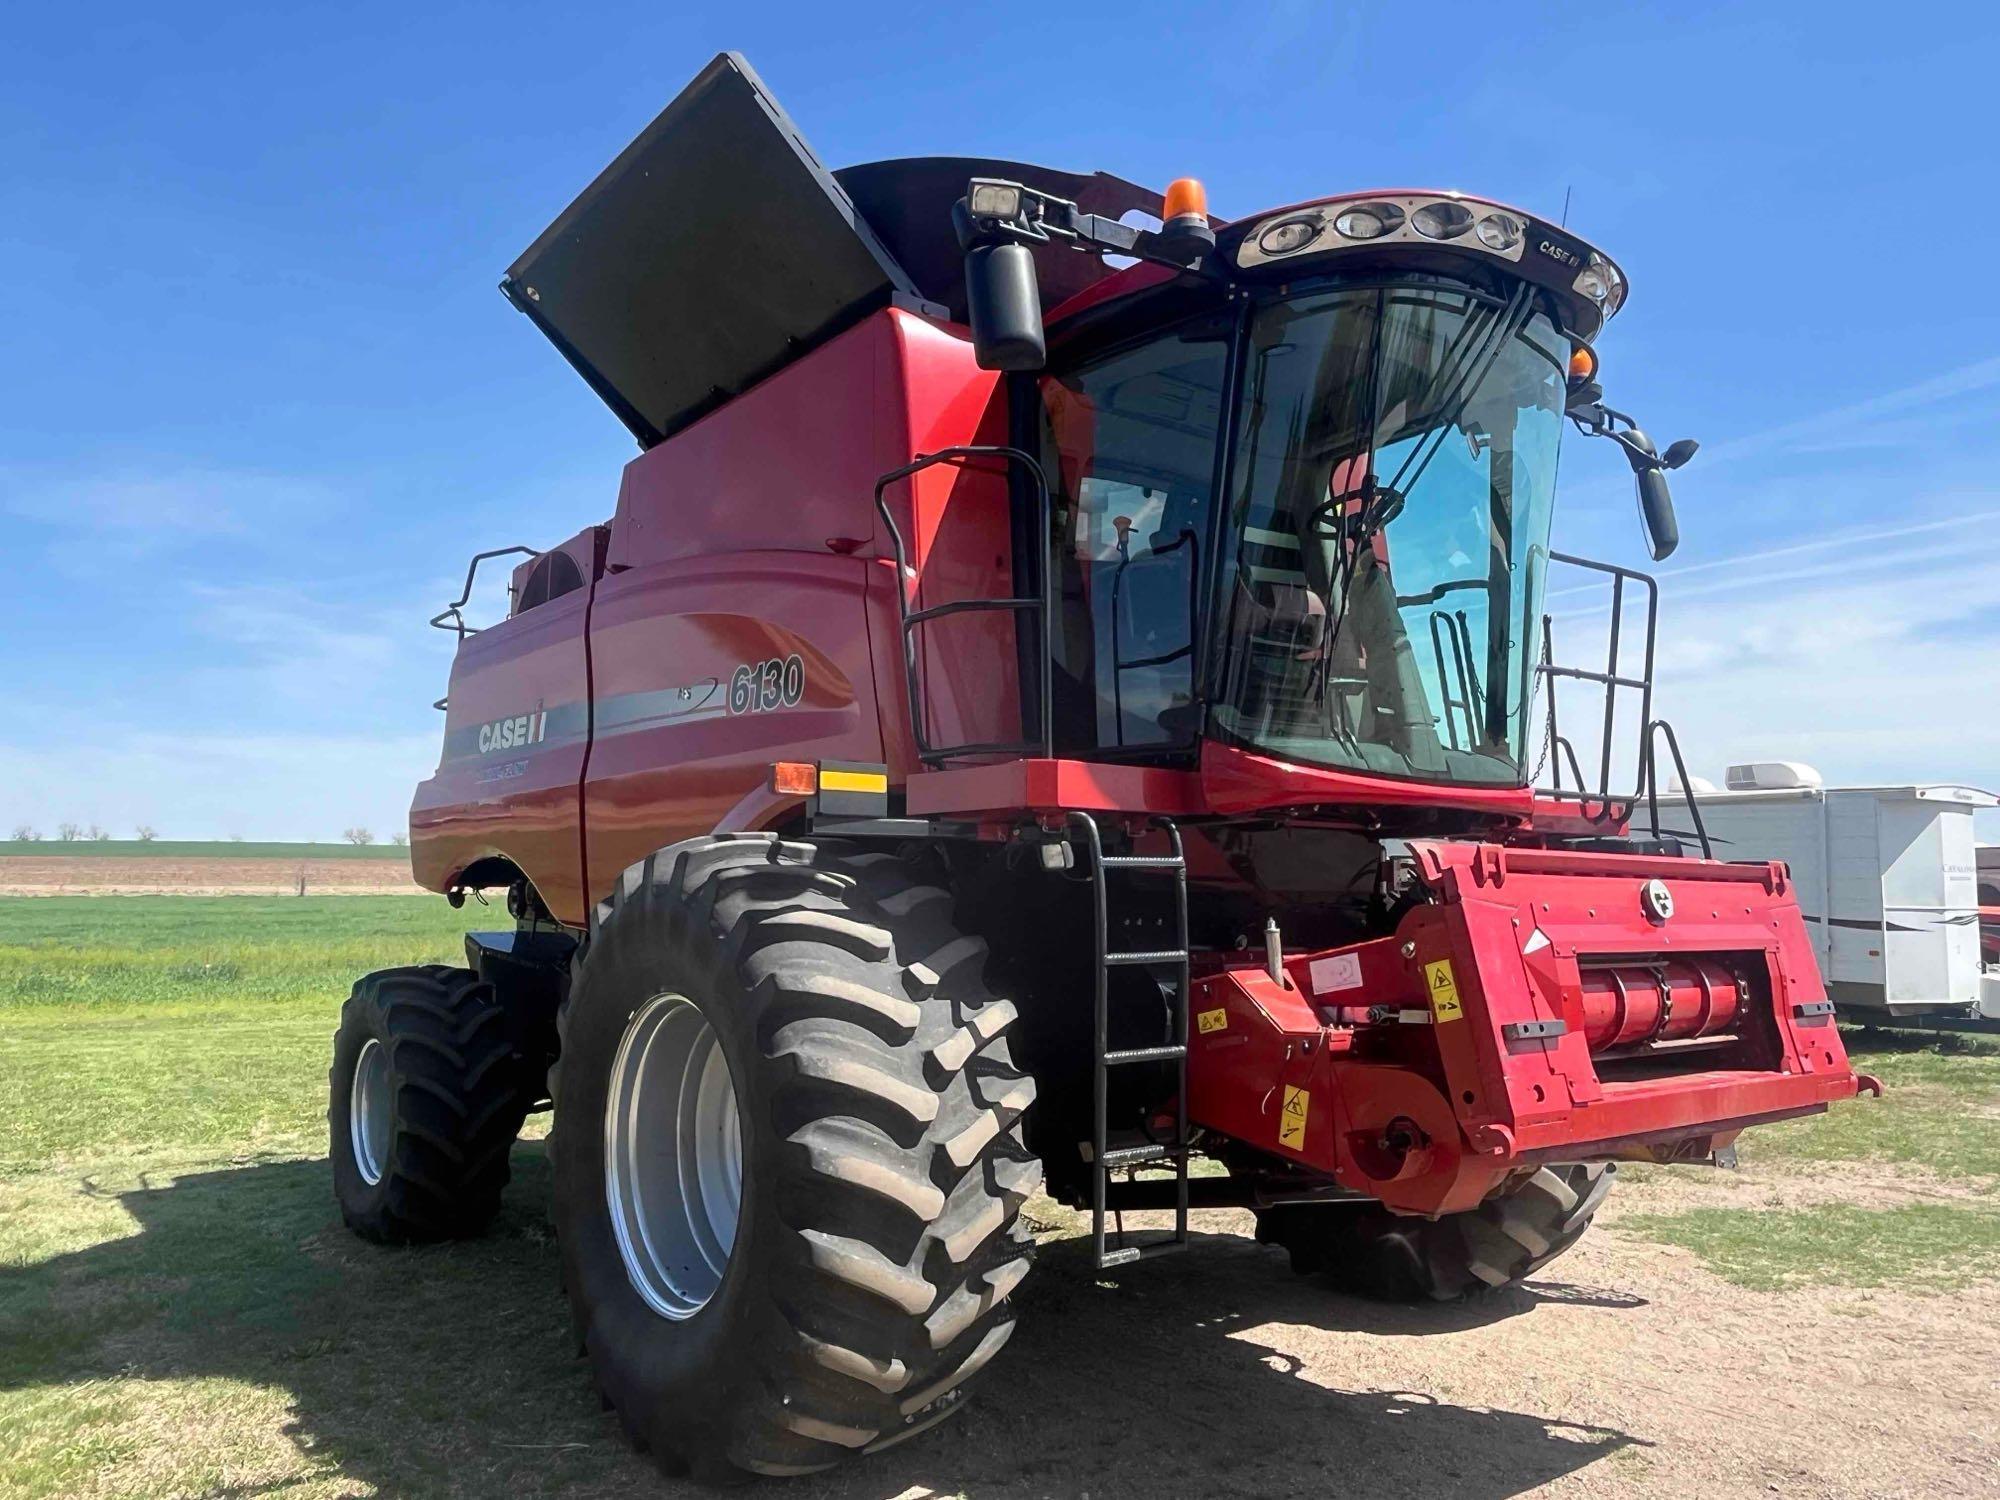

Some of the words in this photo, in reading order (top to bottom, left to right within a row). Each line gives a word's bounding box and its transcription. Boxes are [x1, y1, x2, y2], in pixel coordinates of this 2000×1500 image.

[1540, 241, 1570, 262] CASE
[729, 653, 805, 715] 6130
[479, 716, 528, 754] CASE
